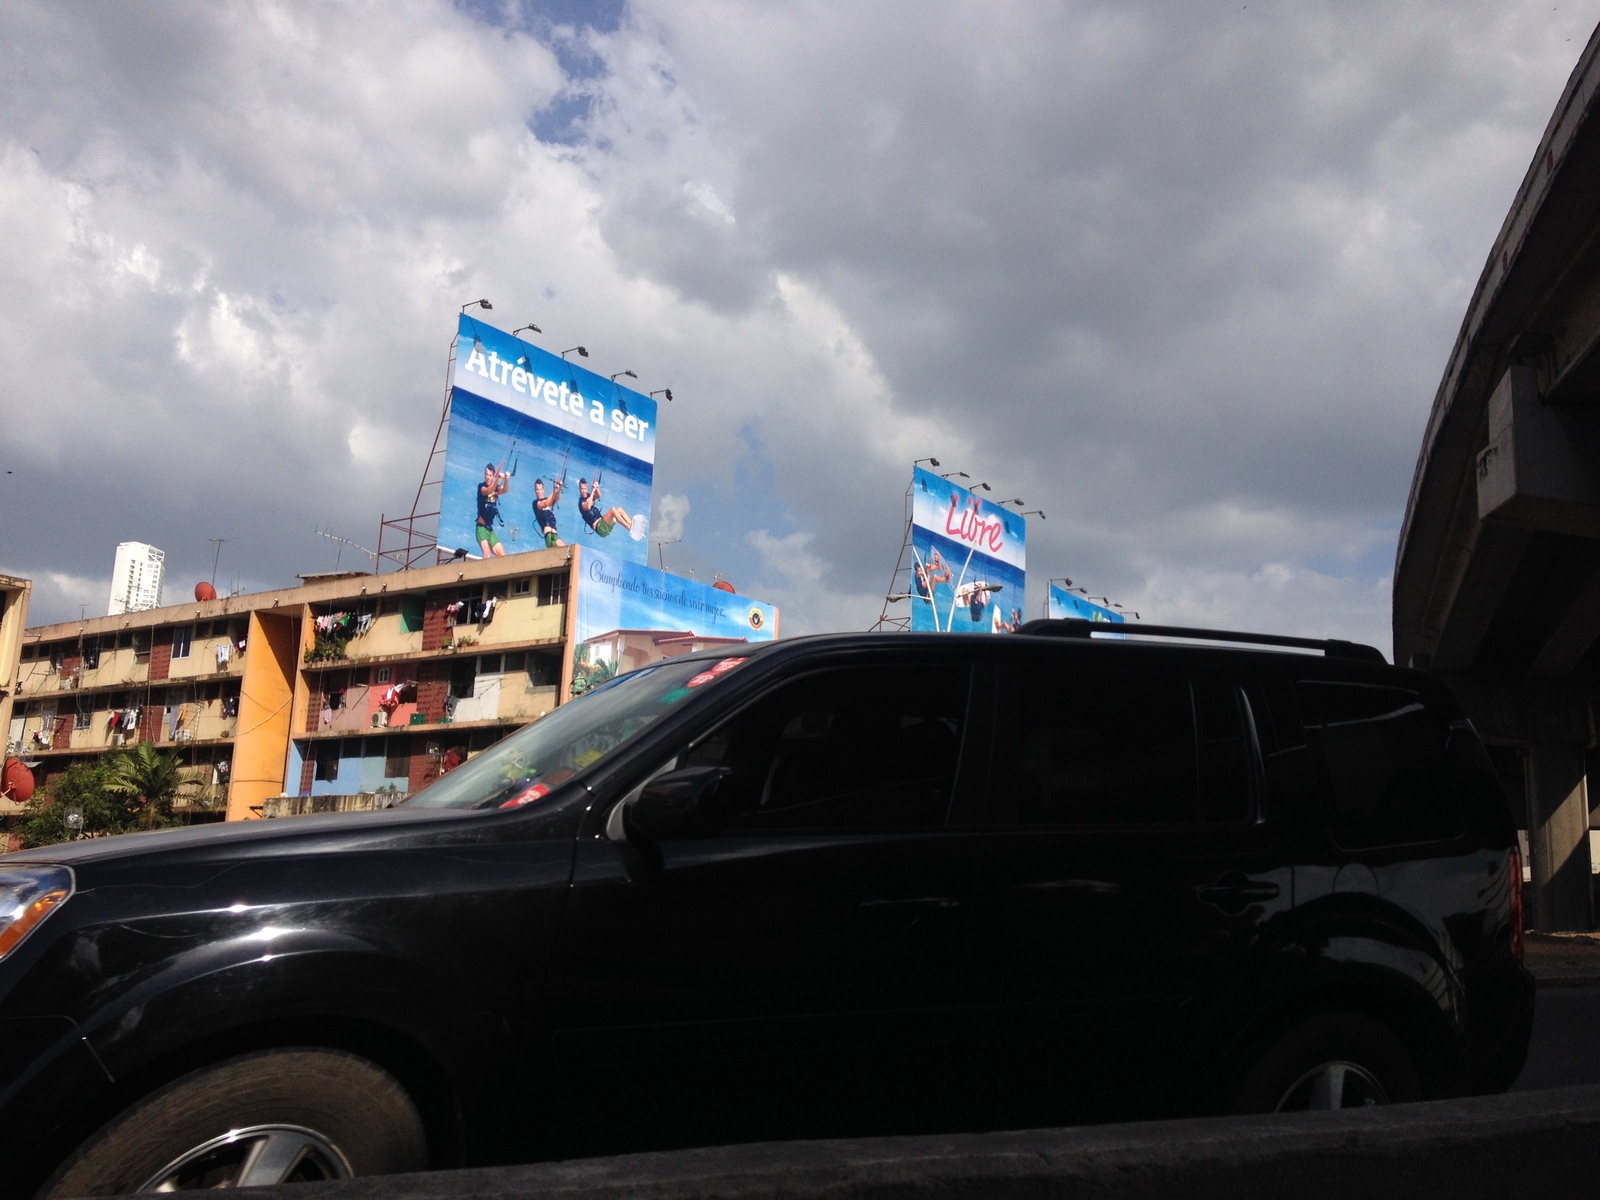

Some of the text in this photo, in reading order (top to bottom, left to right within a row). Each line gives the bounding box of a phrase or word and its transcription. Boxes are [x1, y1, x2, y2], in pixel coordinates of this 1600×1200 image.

[465, 347, 649, 442] Atrévete a ser
[945, 494, 1003, 553] Libre
[589, 559, 640, 594] Cumpliendo
[642, 580, 654, 598] tus
[654, 588, 678, 604] sueños
[678, 589, 688, 608] de
[689, 596, 705, 612] vivir
